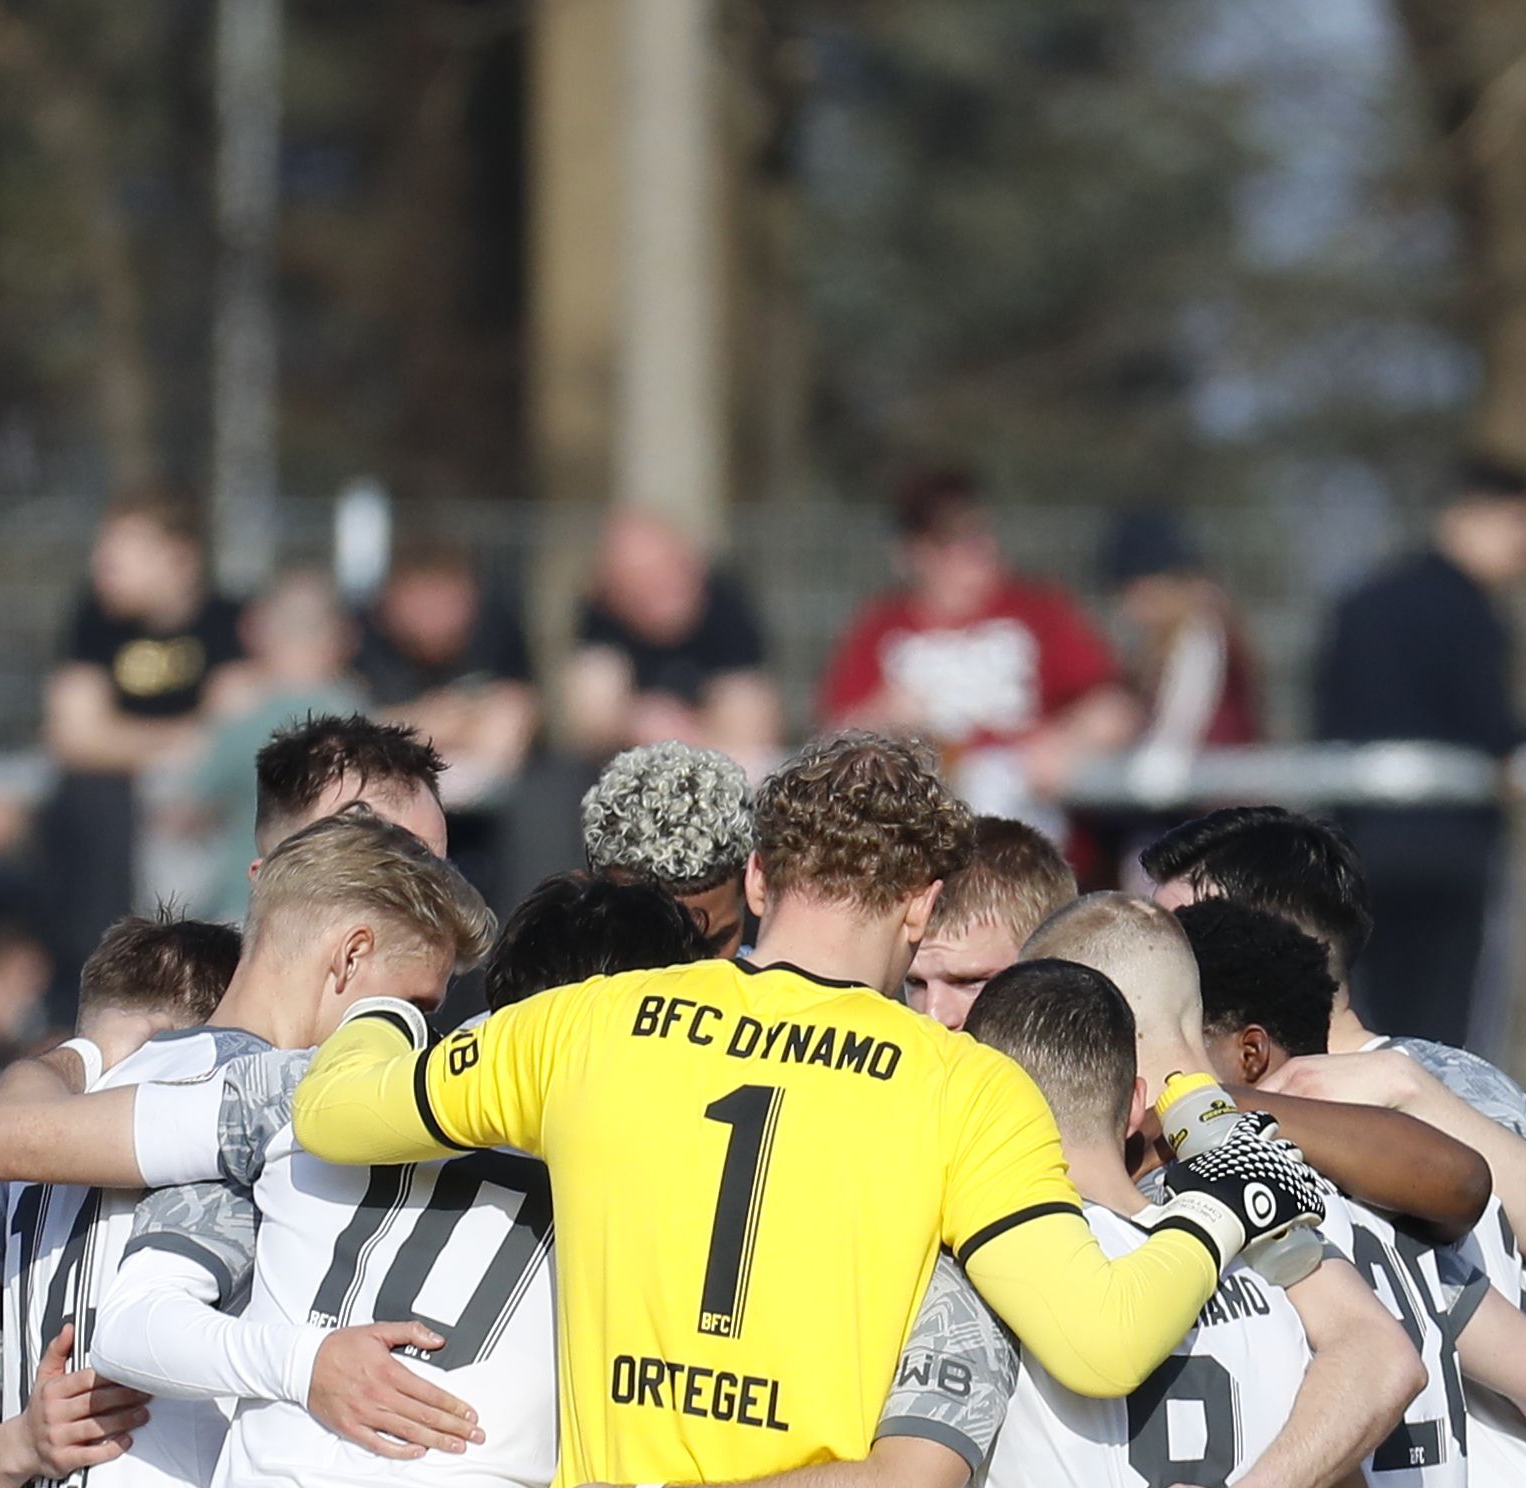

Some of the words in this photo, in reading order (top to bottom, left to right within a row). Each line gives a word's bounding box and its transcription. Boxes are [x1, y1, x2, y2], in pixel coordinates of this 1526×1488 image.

[631, 995, 723, 1046] BFC
[726, 1015, 902, 1081] DYNAMO
[697, 1084, 786, 1339] 1
[701, 1311, 731, 1334] BFC
[611, 1355, 789, 1432] ORTEGEL
